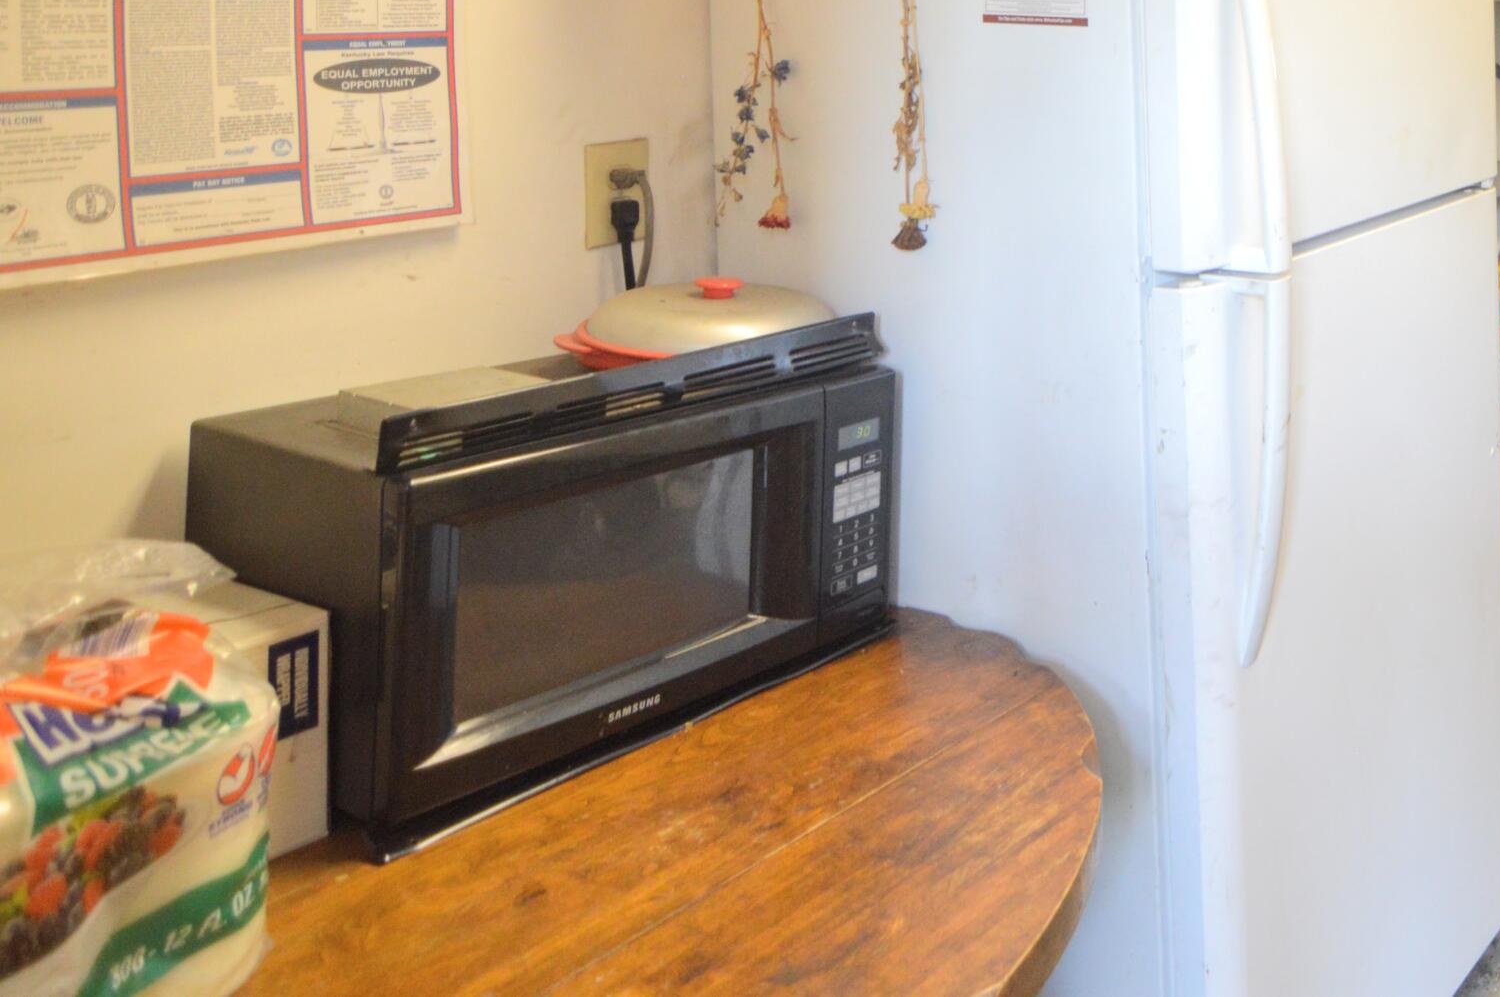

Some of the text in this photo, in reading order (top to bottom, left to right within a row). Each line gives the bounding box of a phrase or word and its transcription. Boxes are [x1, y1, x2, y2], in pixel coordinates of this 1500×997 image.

[321, 65, 433, 80] EQUAL EMPLOYMENT
[341, 78, 416, 91] OPPORTUNITY
[222, 177, 245, 186] NOTICE
[608, 693, 661, 724] SAMSUNG
[232, 881, 253, 917] OZ
